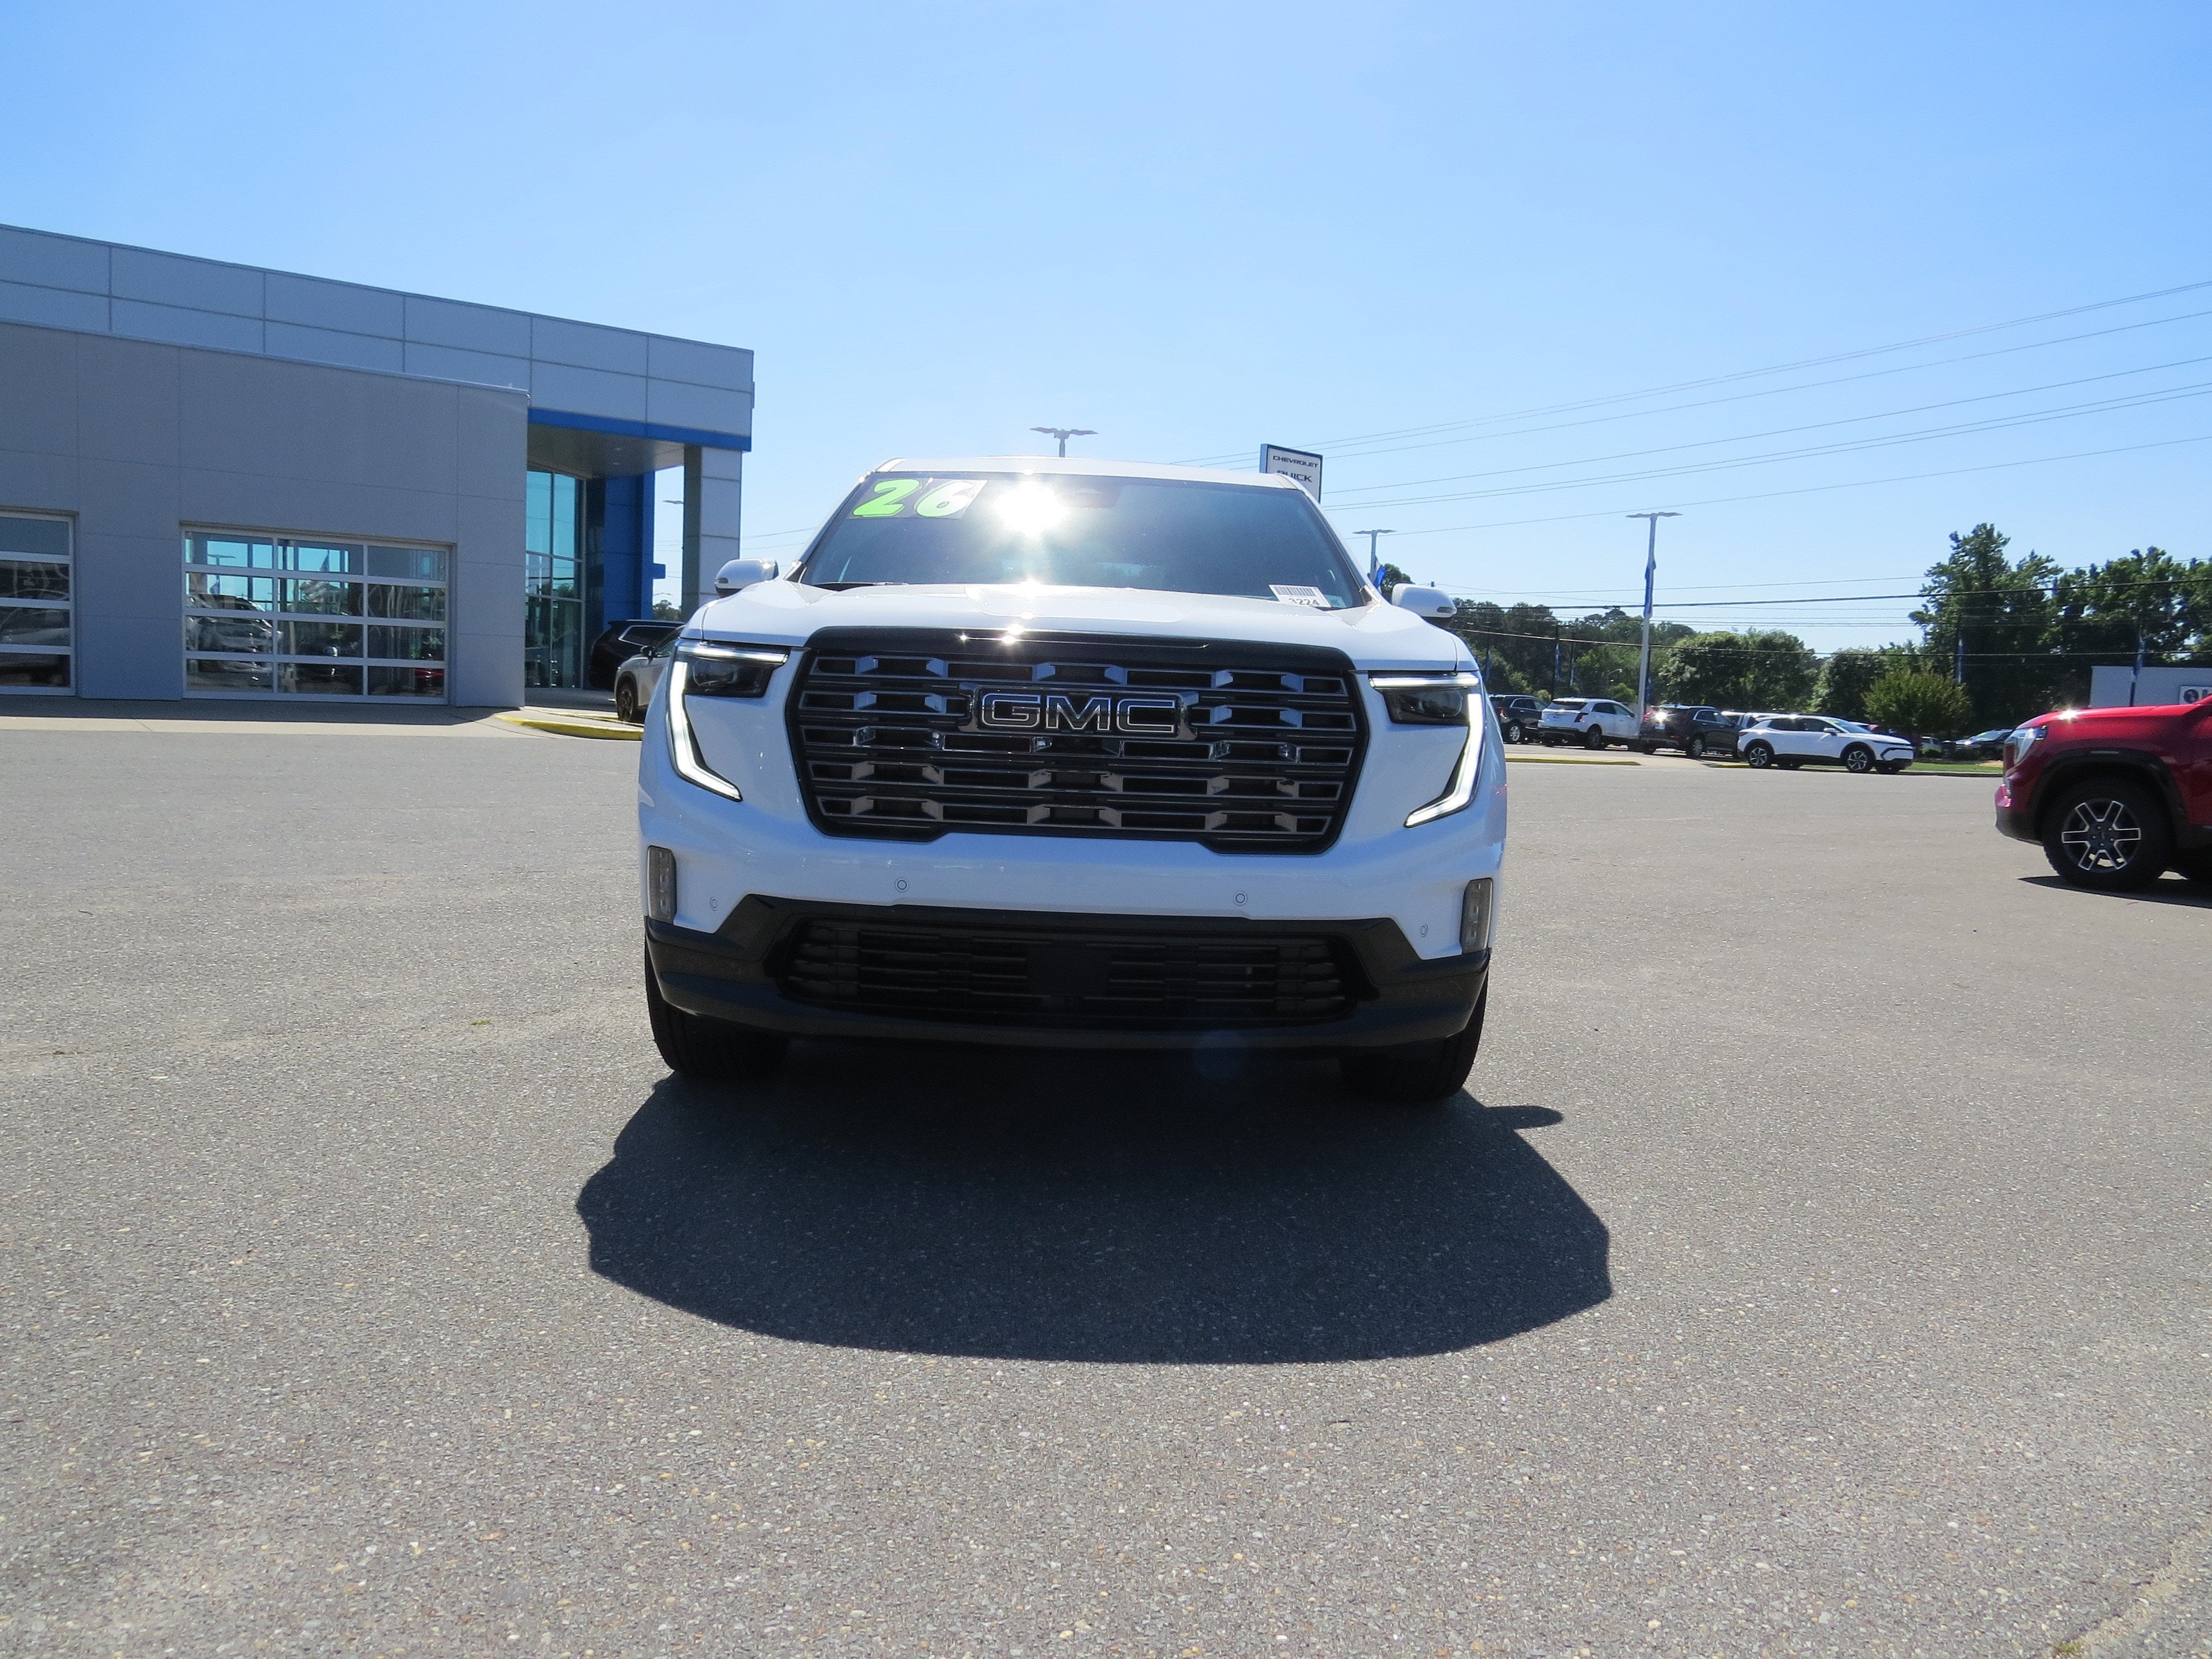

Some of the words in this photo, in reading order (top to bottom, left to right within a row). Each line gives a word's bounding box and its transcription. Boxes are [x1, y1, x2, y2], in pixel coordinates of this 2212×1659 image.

[1273, 455, 1318, 468] CHEVROLET
[853, 479, 975, 518] 26
[982, 693, 1175, 733] GMC
